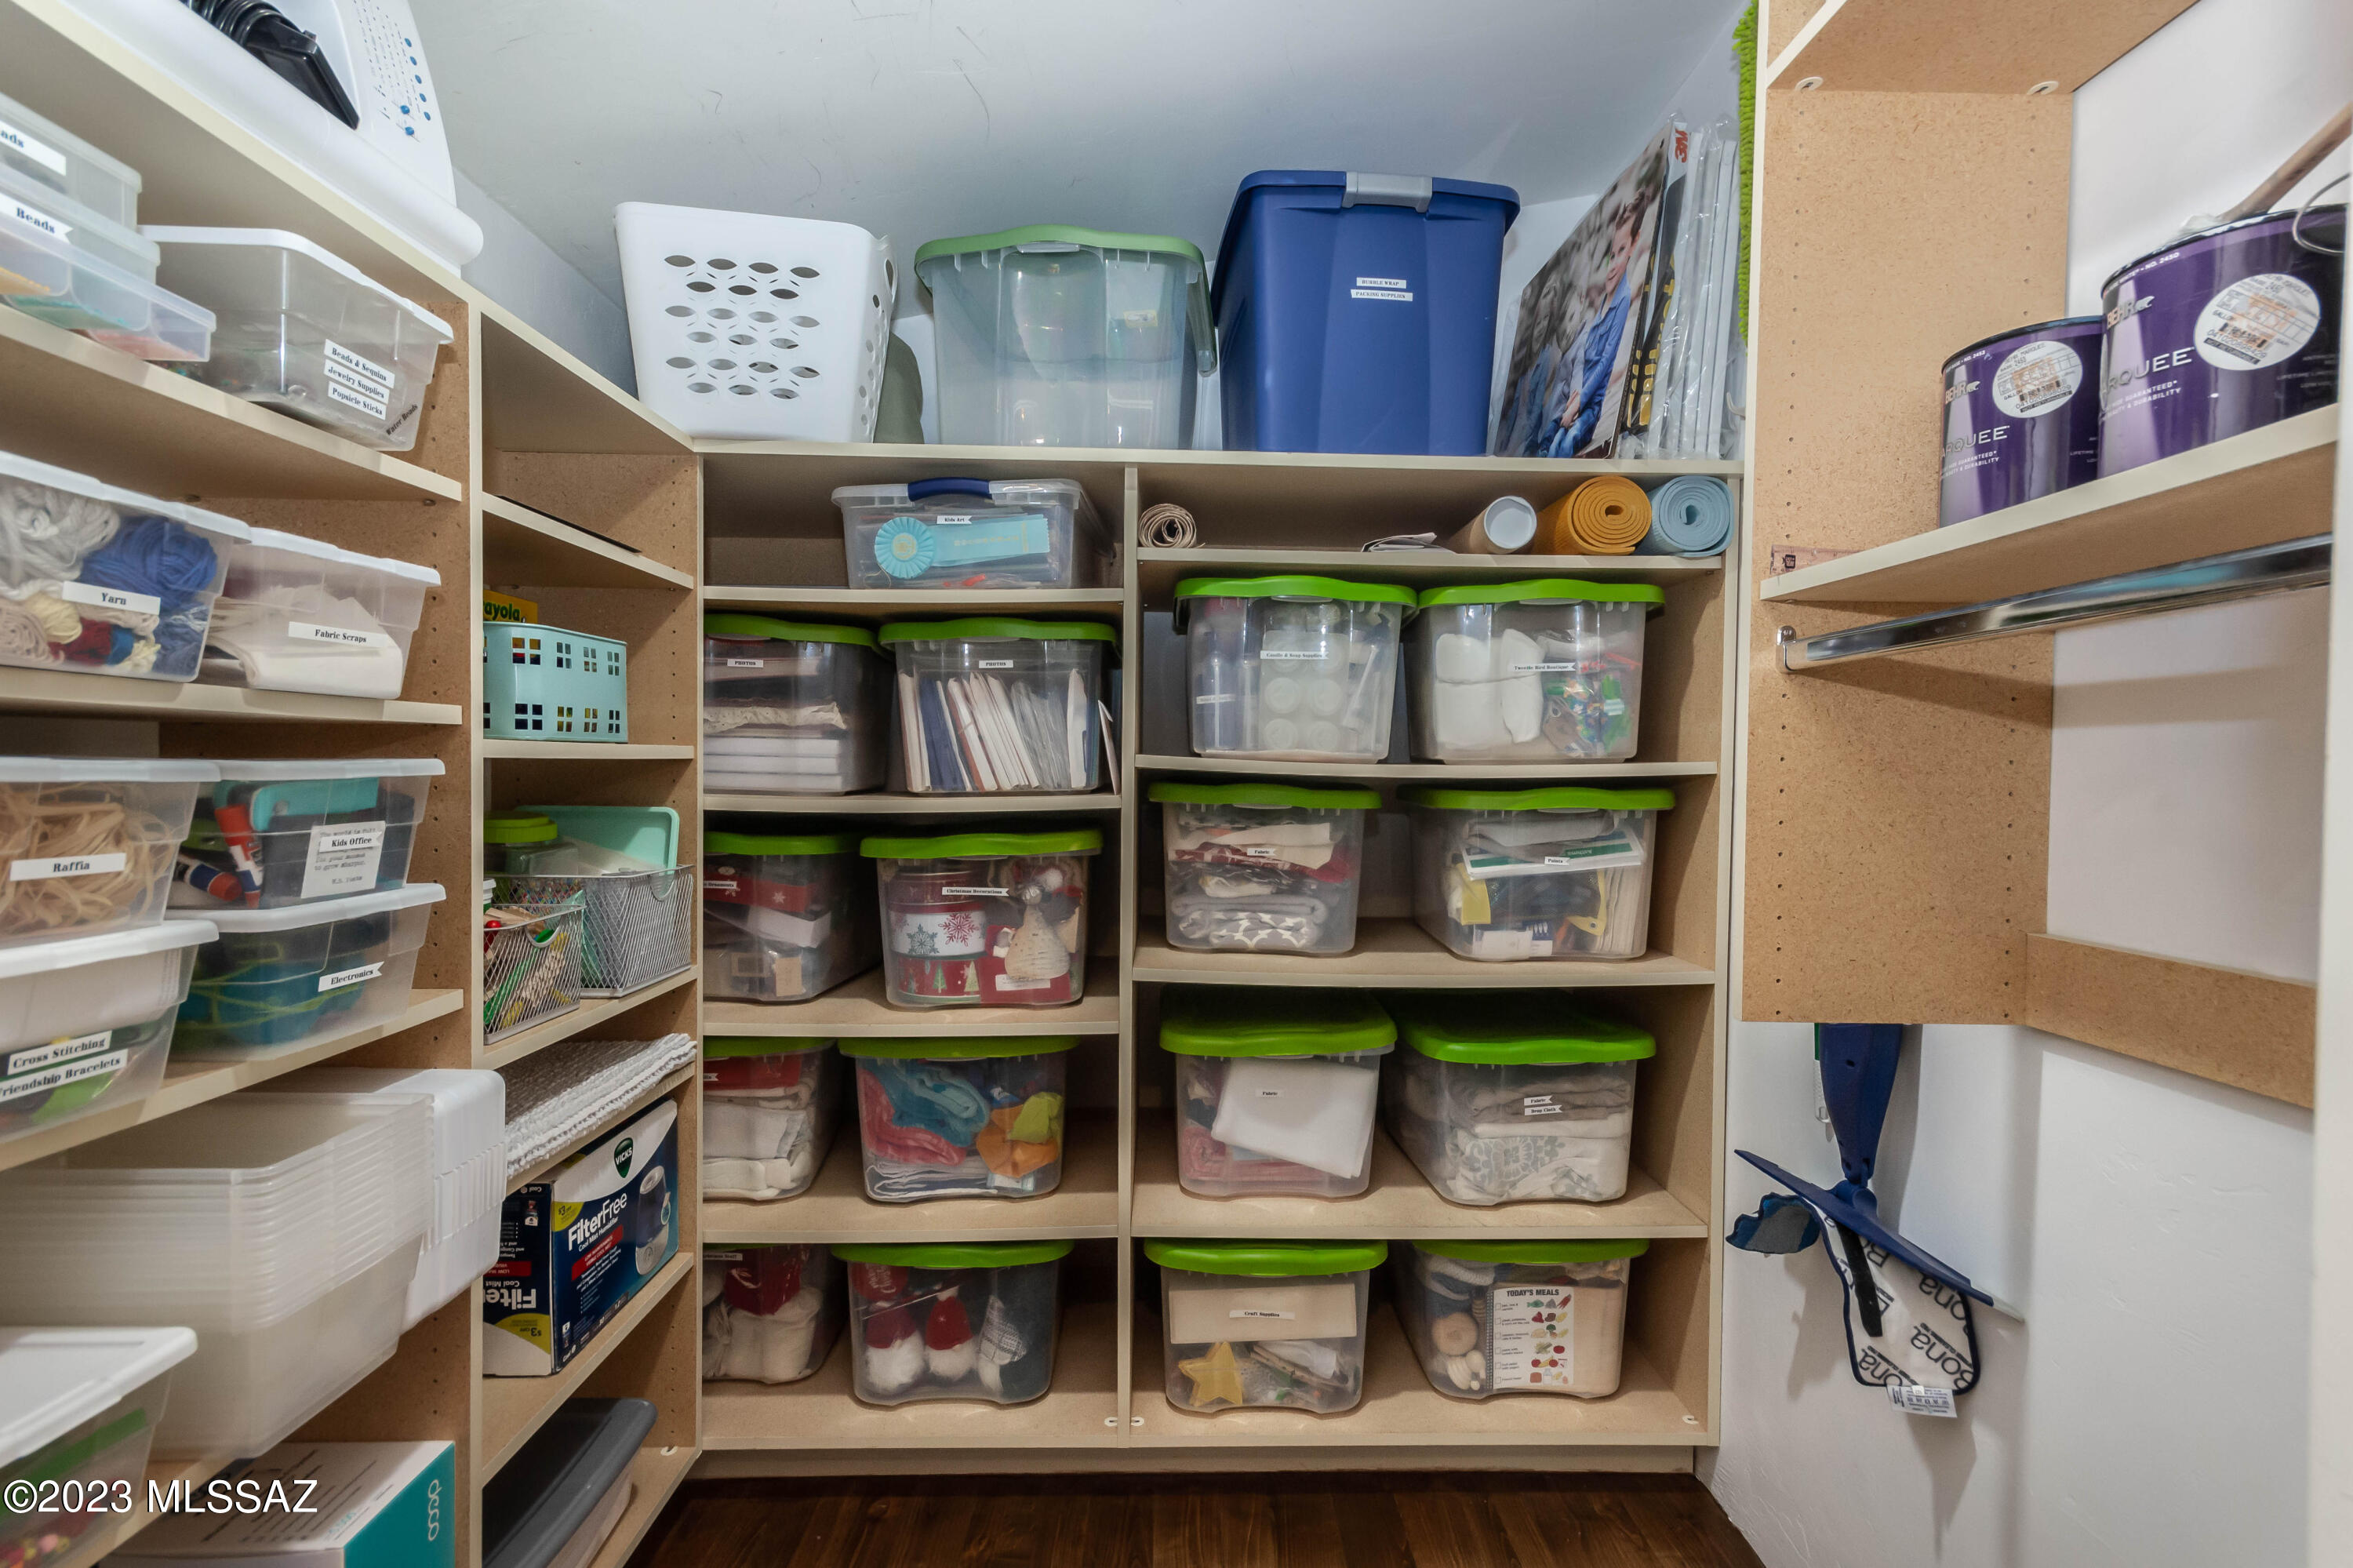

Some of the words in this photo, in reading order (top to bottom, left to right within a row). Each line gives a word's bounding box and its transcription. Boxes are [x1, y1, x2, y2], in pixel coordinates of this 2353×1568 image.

[16, 207, 55, 234] Beads
[2107, 300, 2135, 329] BEHR
[332, 347, 353, 363] Beads
[362, 363, 387, 381] Sequins
[328, 366, 355, 384] Jewelry
[358, 380, 384, 398] Supplies
[1945, 380, 1967, 404] BEHR
[333, 387, 361, 405] Popsicle
[363, 401, 383, 415] Sticks
[2133, 387, 2181, 406] DURABILITY
[386, 418, 402, 436] Water
[402, 404, 418, 421] Beads
[102, 592, 127, 606] Yarn
[483, 602, 520, 621] ayola
[315, 628, 340, 639] Fabric
[342, 633, 366, 643] Scraps
[349, 837, 373, 846] Office
[53, 860, 90, 872] Raffia
[331, 970, 373, 985] Electronics
[13, 1054, 49, 1068] Cross
[52, 1038, 107, 1058] Stitching
[0, 1074, 61, 1097] riendship
[65, 1057, 121, 1079] Bracelets
[615, 1147, 633, 1166] VICKS
[568, 1192, 627, 1251] FilterFree
[578, 1238, 589, 1252] Cool
[589, 1231, 598, 1244] Mist
[483, 1289, 536, 1310] Filte
[1919, 1272, 1968, 1321] ona
[1910, 1325, 1974, 1389] Bona
